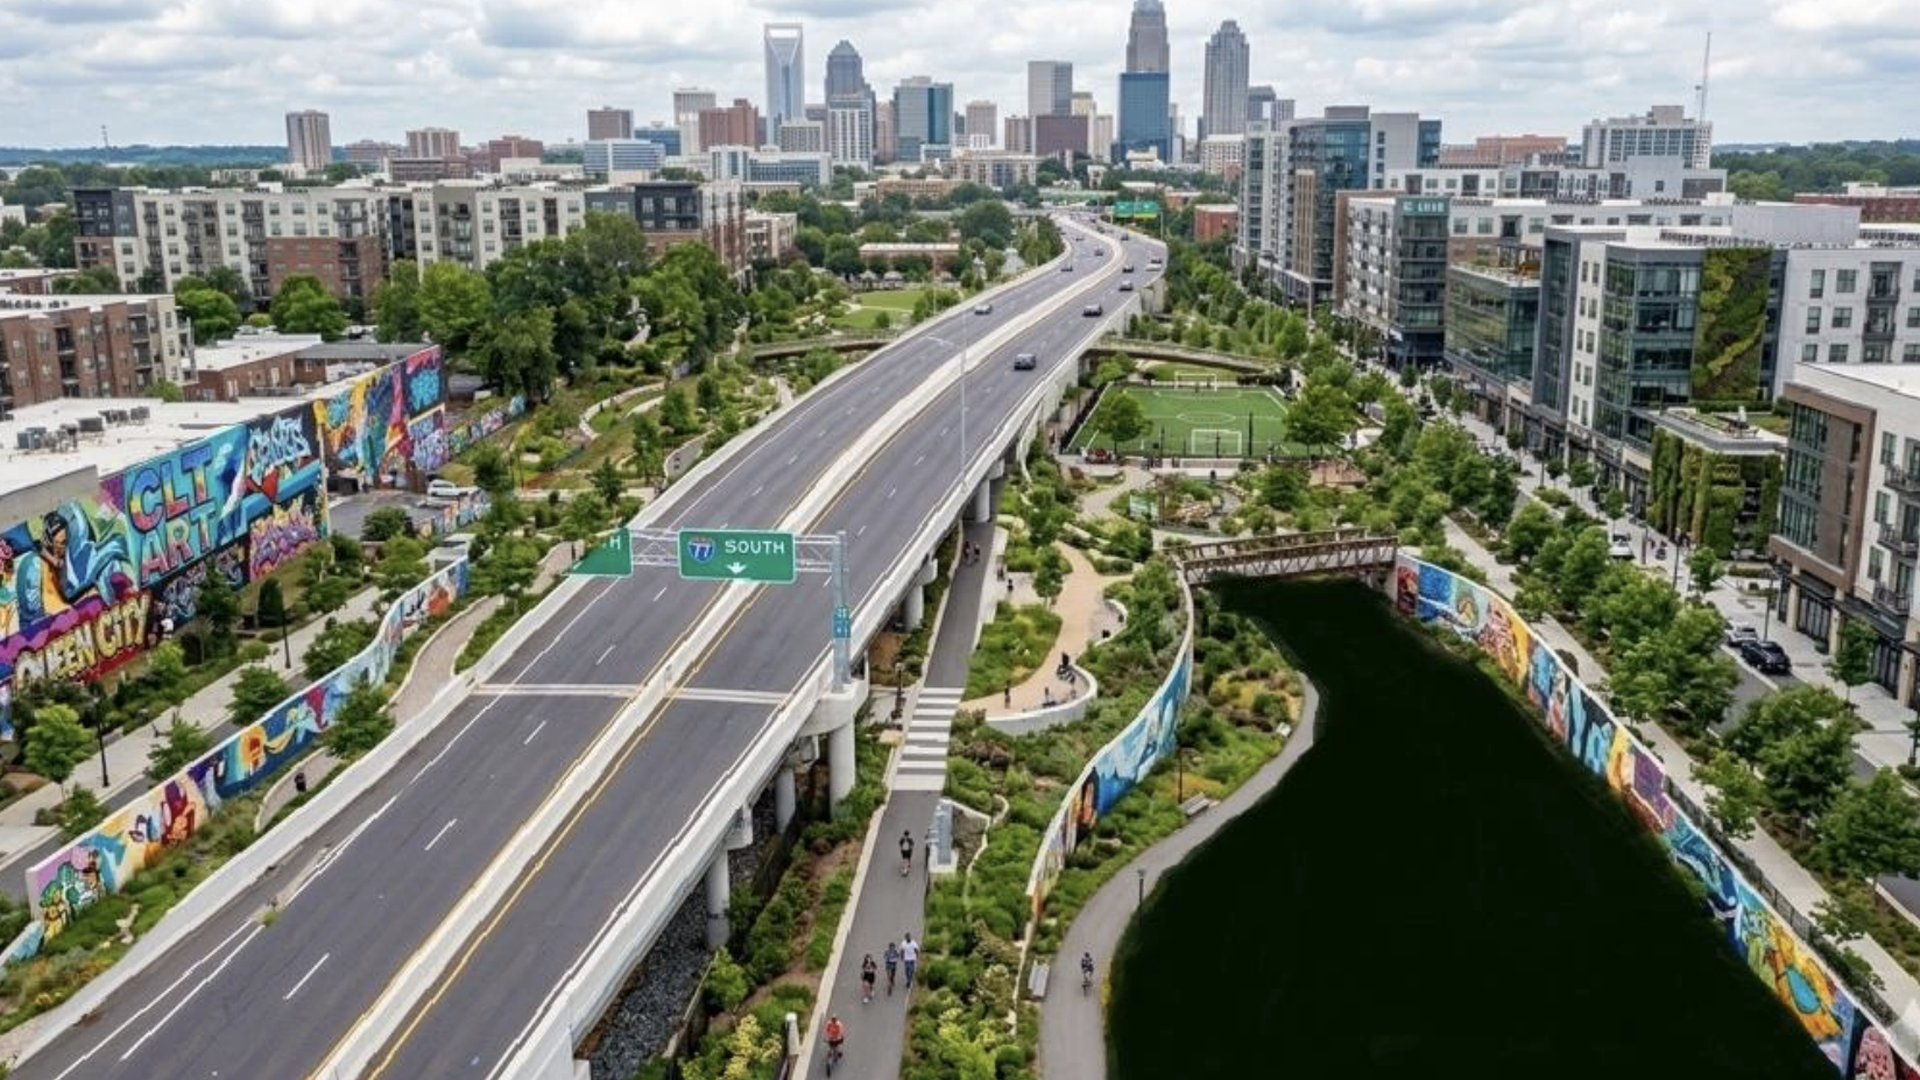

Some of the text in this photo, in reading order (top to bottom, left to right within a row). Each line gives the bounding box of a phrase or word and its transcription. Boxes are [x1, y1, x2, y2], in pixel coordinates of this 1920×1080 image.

[129, 445, 212, 533] CLT
[140, 500, 217, 587] ART
[694, 542, 710, 558] 77
[725, 540, 786, 555] SOUTH
[97, 593, 152, 660] CITY
